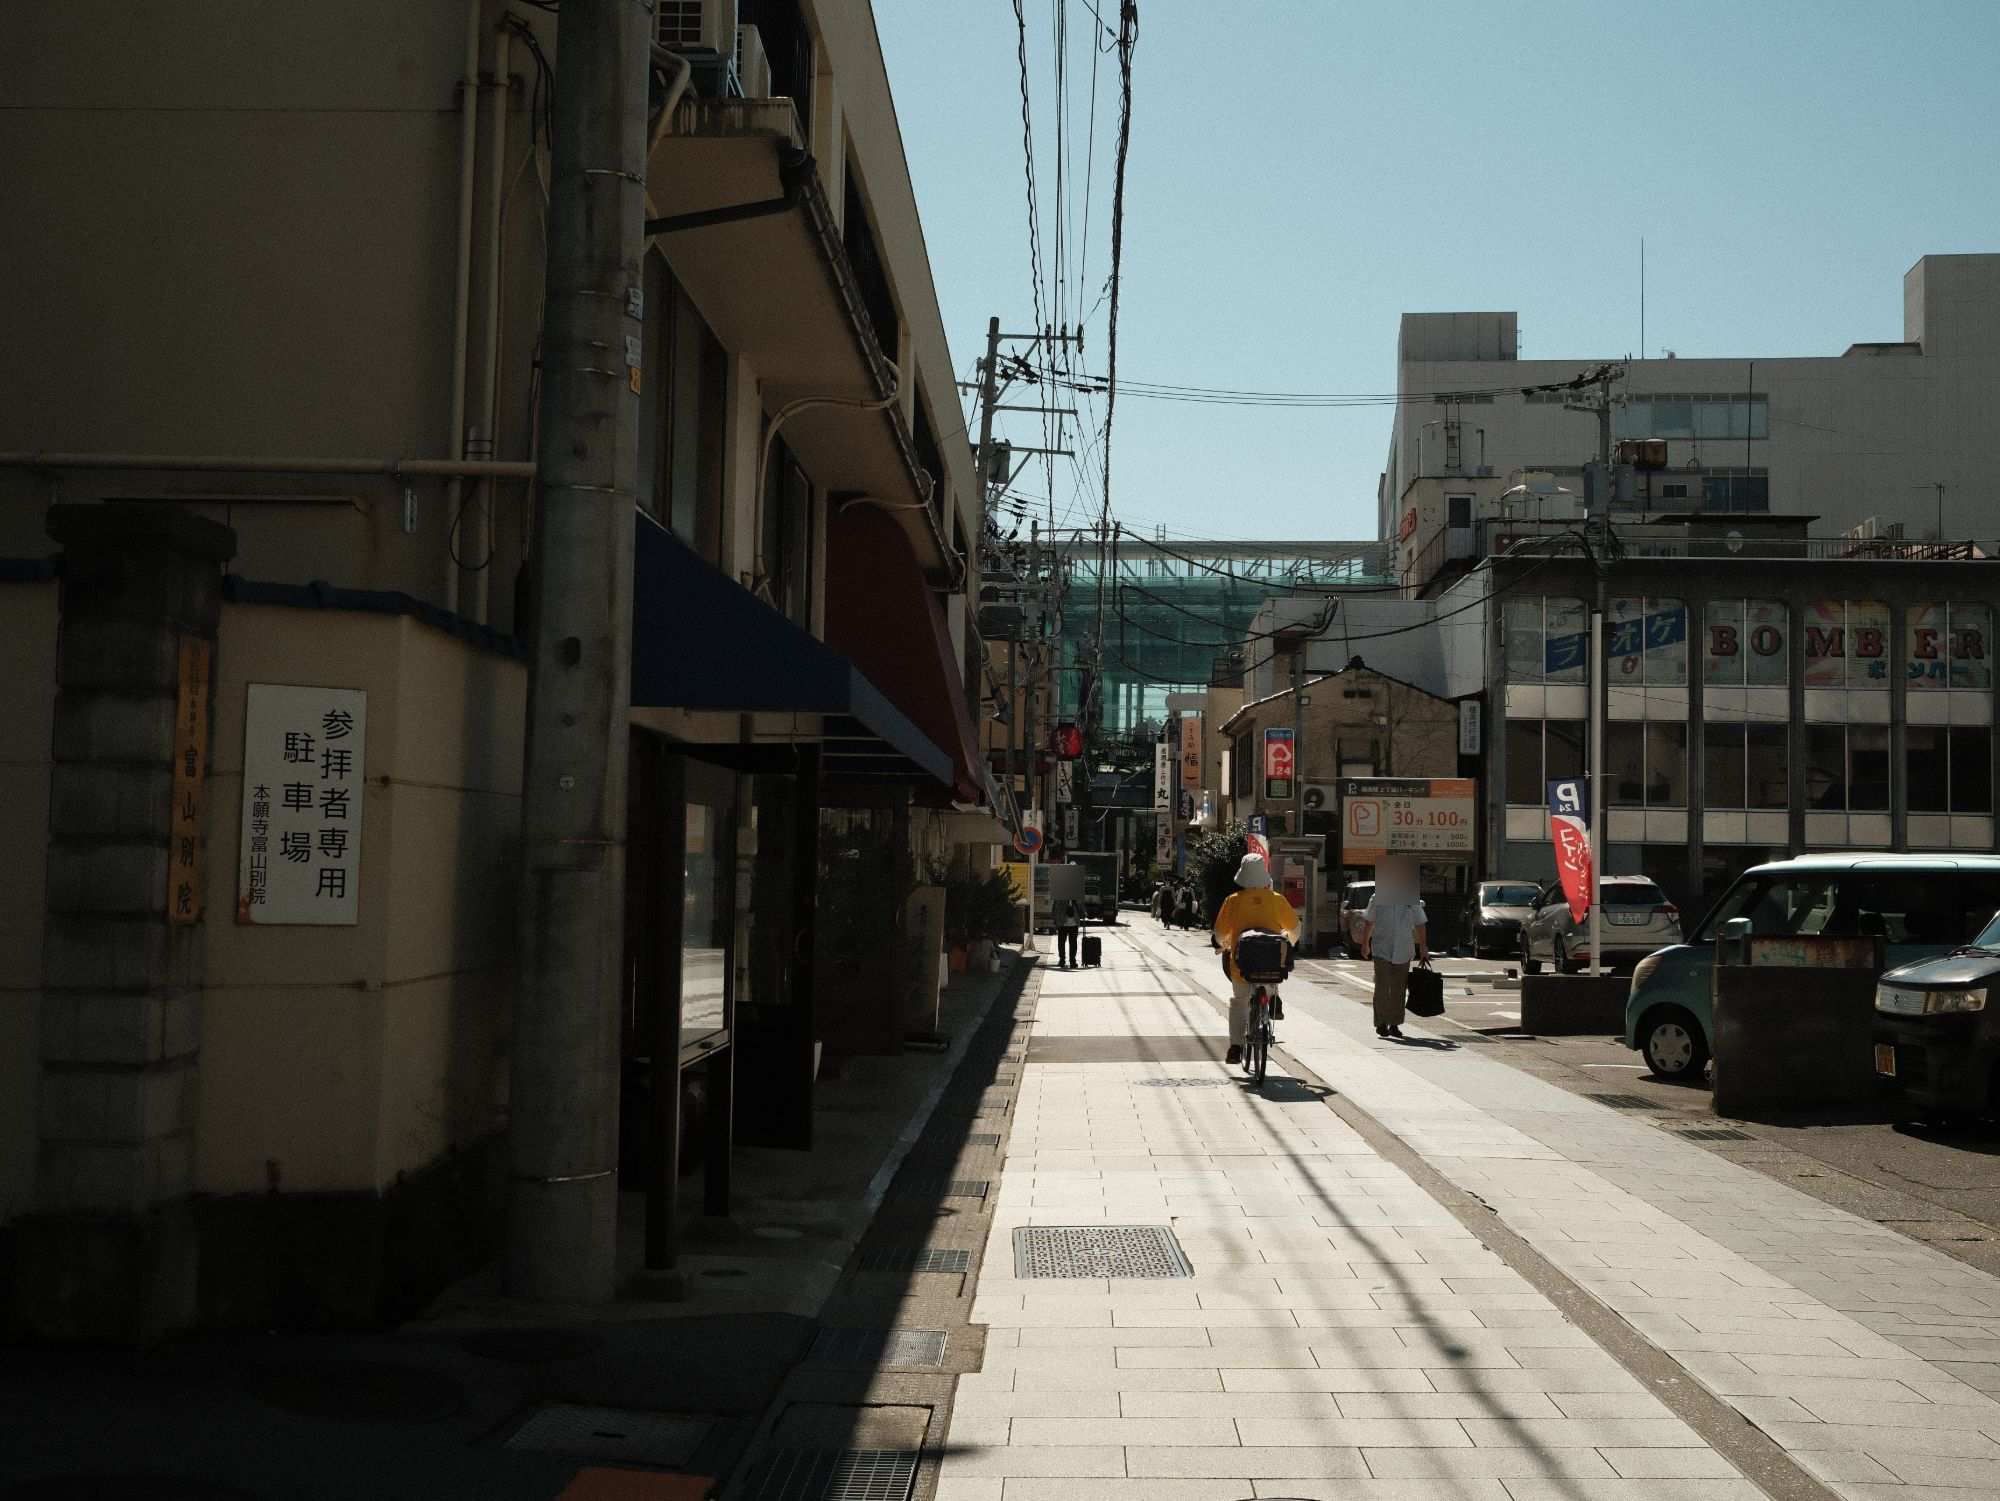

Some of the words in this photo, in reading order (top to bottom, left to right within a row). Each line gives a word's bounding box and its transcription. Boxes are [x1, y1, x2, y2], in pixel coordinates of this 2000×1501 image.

[1710, 624, 1985, 659] BOMBER
[1869, 660, 1968, 679] ボンバー
[249, 784, 271, 905] 本願寺富山別院
[280, 732, 316, 863] 駐車場
[316, 709, 354, 898] 参拝者専用
